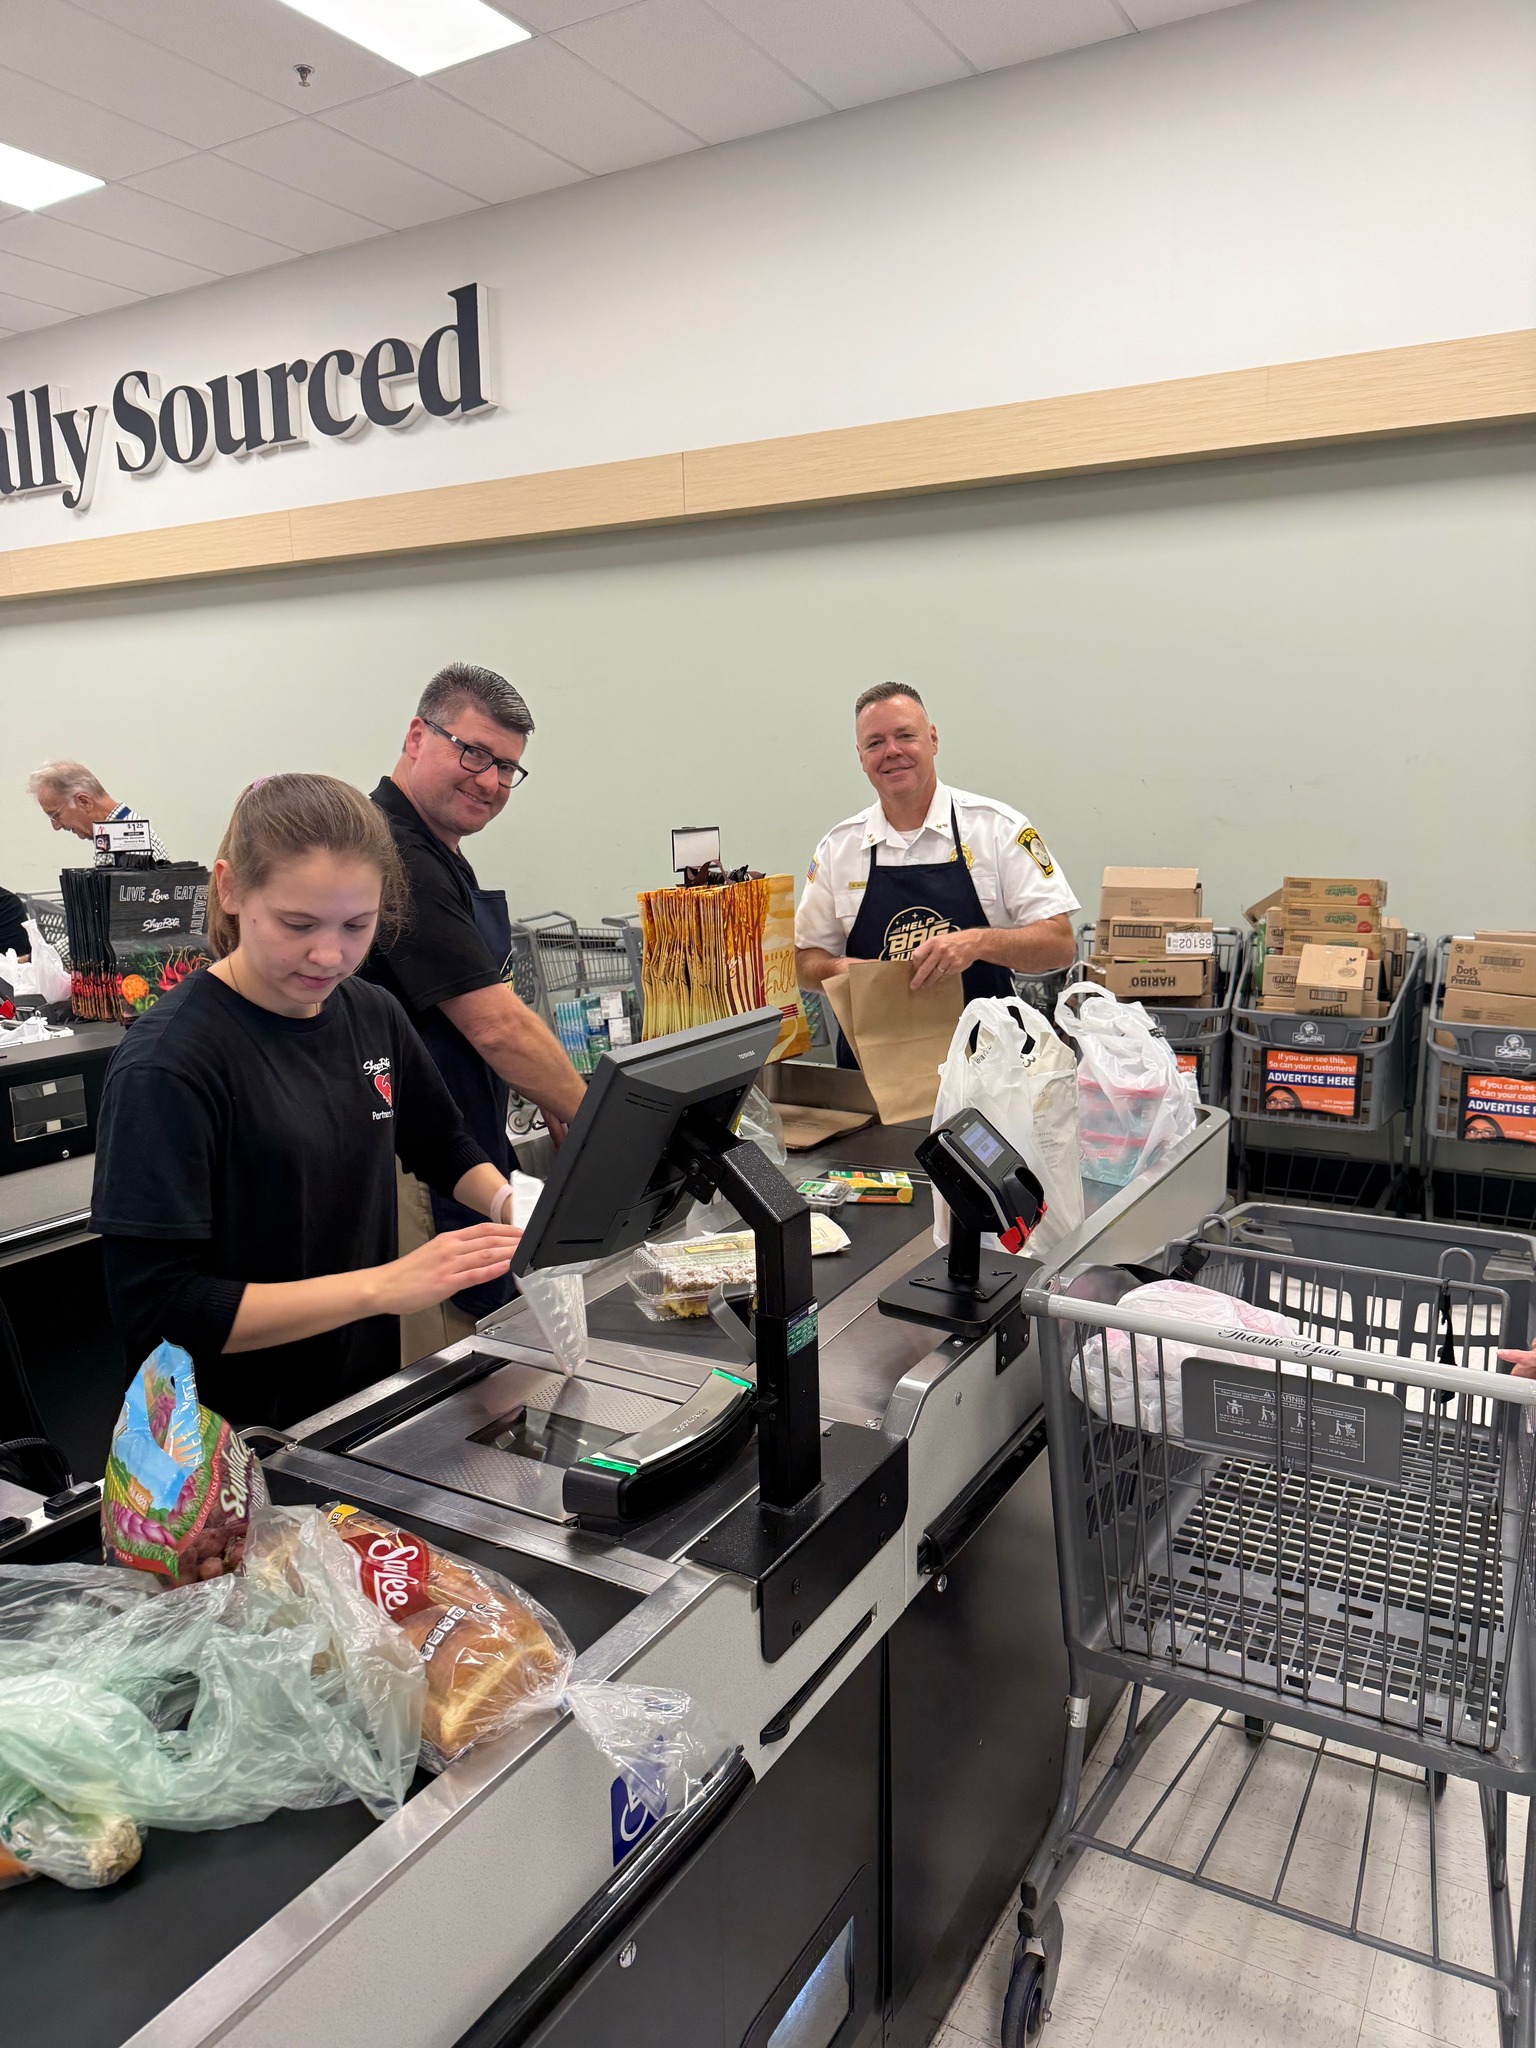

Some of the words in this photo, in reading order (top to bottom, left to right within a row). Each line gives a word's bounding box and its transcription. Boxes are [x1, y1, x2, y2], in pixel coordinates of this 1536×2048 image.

[112, 282, 489, 473] Sourced
[120, 885, 146, 902] LIVE
[148, 888, 170, 904] Love
[174, 885, 196, 900] EAT
[190, 884, 209, 936] HEALTHY
[141, 917, 180, 933] ShopRite
[902, 917, 935, 932] HELP
[888, 922, 951, 954] BAG
[1179, 938, 1212, 949] 65102
[1456, 965, 1478, 976] Dot's
[1131, 977, 1176, 987] HARIBO
[1450, 976, 1481, 986] Pretzels
[1330, 1057, 1346, 1065] this,
[1268, 1072, 1324, 1084] ADVERTISE
[1327, 1076, 1355, 1086] HERE
[1468, 1100, 1531, 1115] ADVERTISE
[1218, 1328, 1283, 1347] Thank
[1291, 1340, 1342, 1358] You
[189, 1521, 202, 1538] RED
[200, 1480, 219, 1519] SEEDLESS
[374, 1570, 419, 1618] Lee
